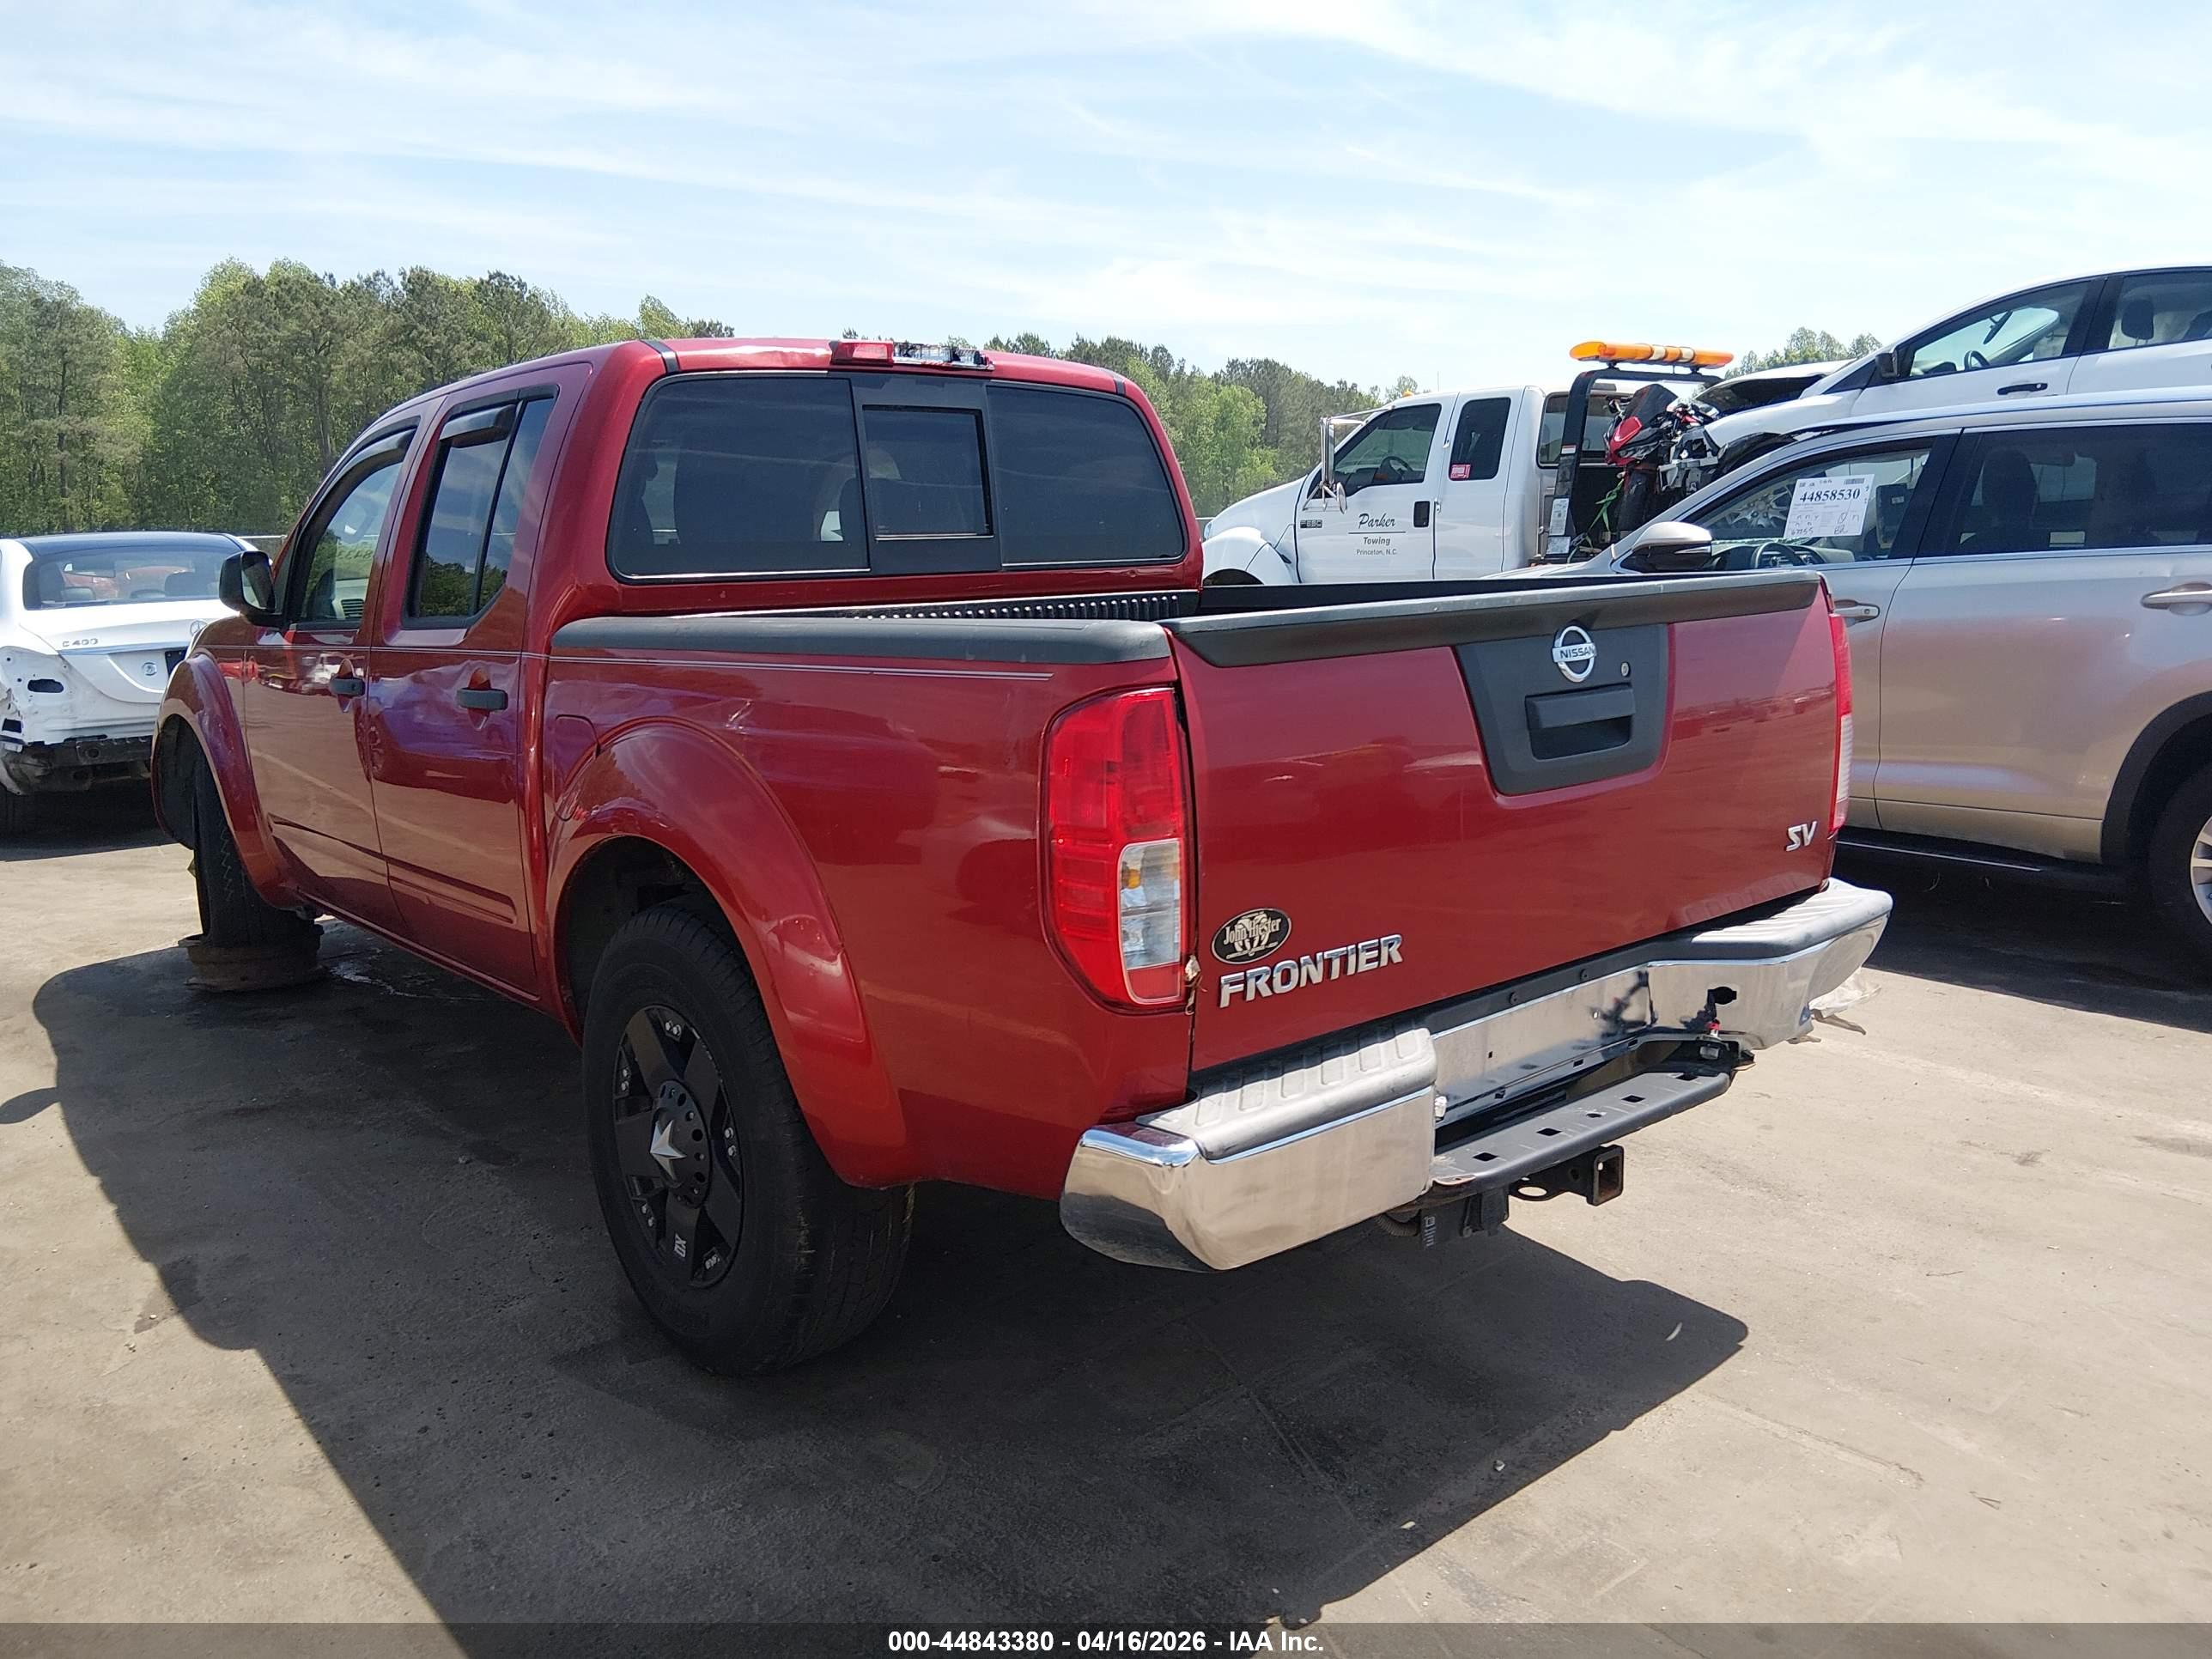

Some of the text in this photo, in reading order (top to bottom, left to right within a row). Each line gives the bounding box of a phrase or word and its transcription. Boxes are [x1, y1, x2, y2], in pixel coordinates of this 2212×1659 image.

[1799, 488, 1861, 502] 44858530
[1358, 513, 1396, 529] Parker
[1363, 537, 1391, 546] Towing
[1559, 646, 1595, 659] NISSAN
[1786, 820, 1818, 852] SV
[1223, 925, 1248, 945] John
[1219, 933, 1403, 1008] FRONTIER
